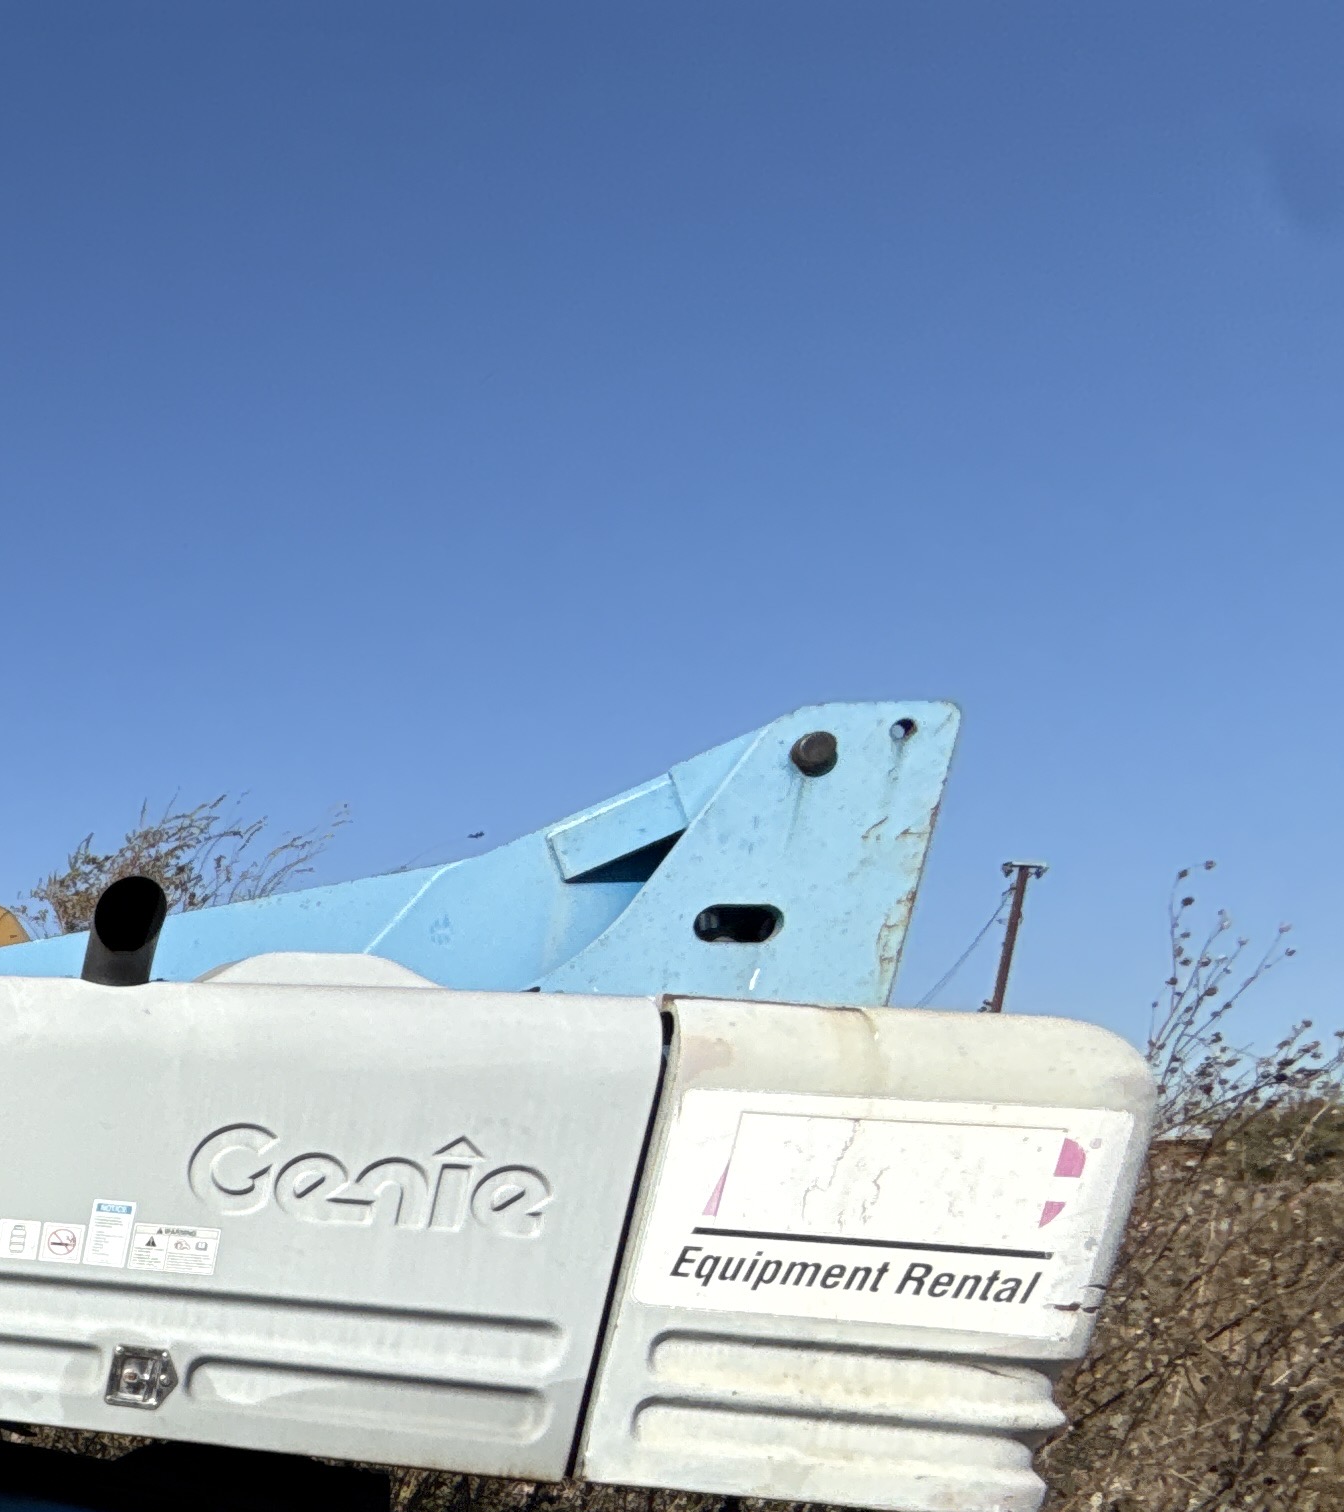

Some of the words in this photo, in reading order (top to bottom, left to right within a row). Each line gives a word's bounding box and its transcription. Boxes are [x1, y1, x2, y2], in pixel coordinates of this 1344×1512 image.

[99, 1203, 128, 1214] NOTICE
[186, 1121, 555, 1239] Genie
[669, 1246, 889, 1293] Equipment
[894, 1262, 1043, 1305] Rental
